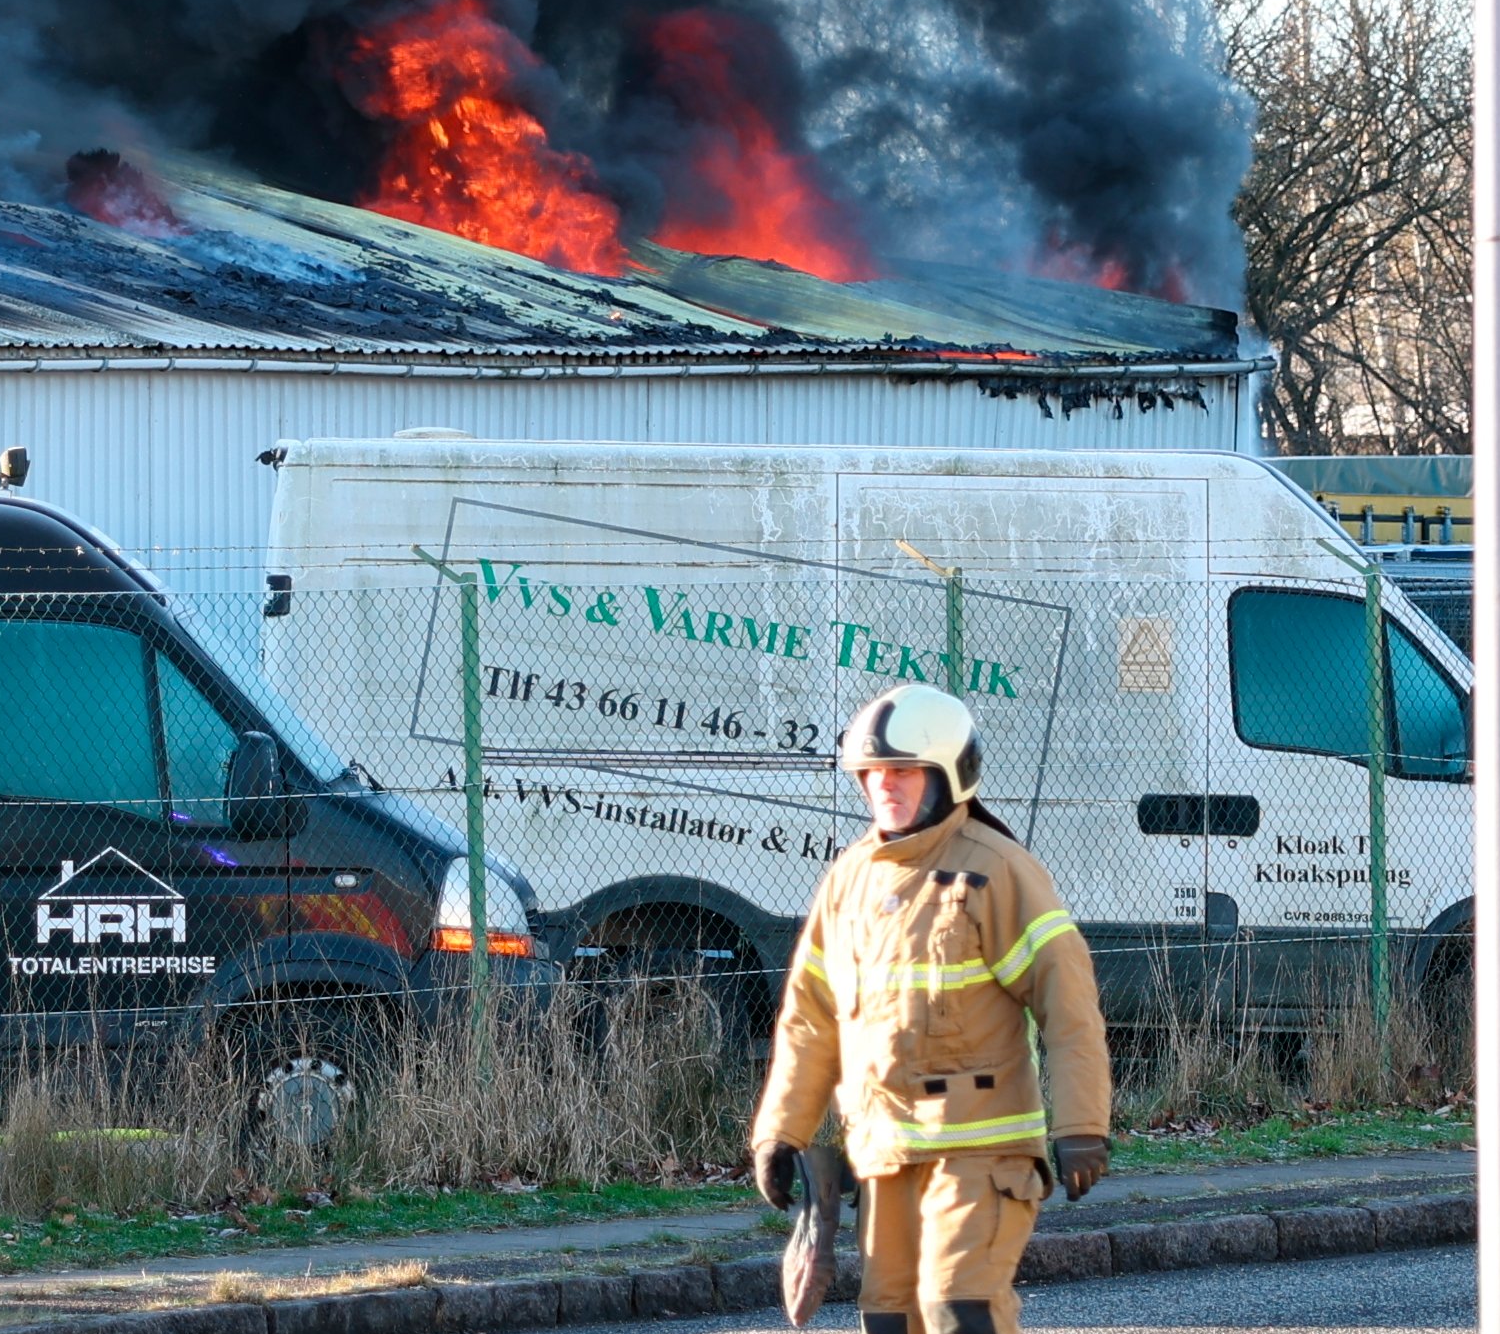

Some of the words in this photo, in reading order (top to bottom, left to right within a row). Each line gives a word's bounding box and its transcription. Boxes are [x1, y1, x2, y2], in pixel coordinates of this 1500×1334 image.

[585, 591, 623, 627] &
[482, 665, 542, 703] Tlf
[545, 677, 587, 711] 43
[599, 688, 640, 721] 66
[656, 700, 686, 730] 11
[701, 709, 742, 741] 46
[776, 719, 820, 755] 32
[434, 766, 501, 800] At.
[514, 777, 753, 847] VVS-installatør
[762, 827, 789, 854] &
[1277, 835, 1346, 855] Kloak
[36, 903, 187, 944] HRH
[1284, 912, 1311, 921] CVR
[9, 956, 216, 975] TOTALENTREPRISE
